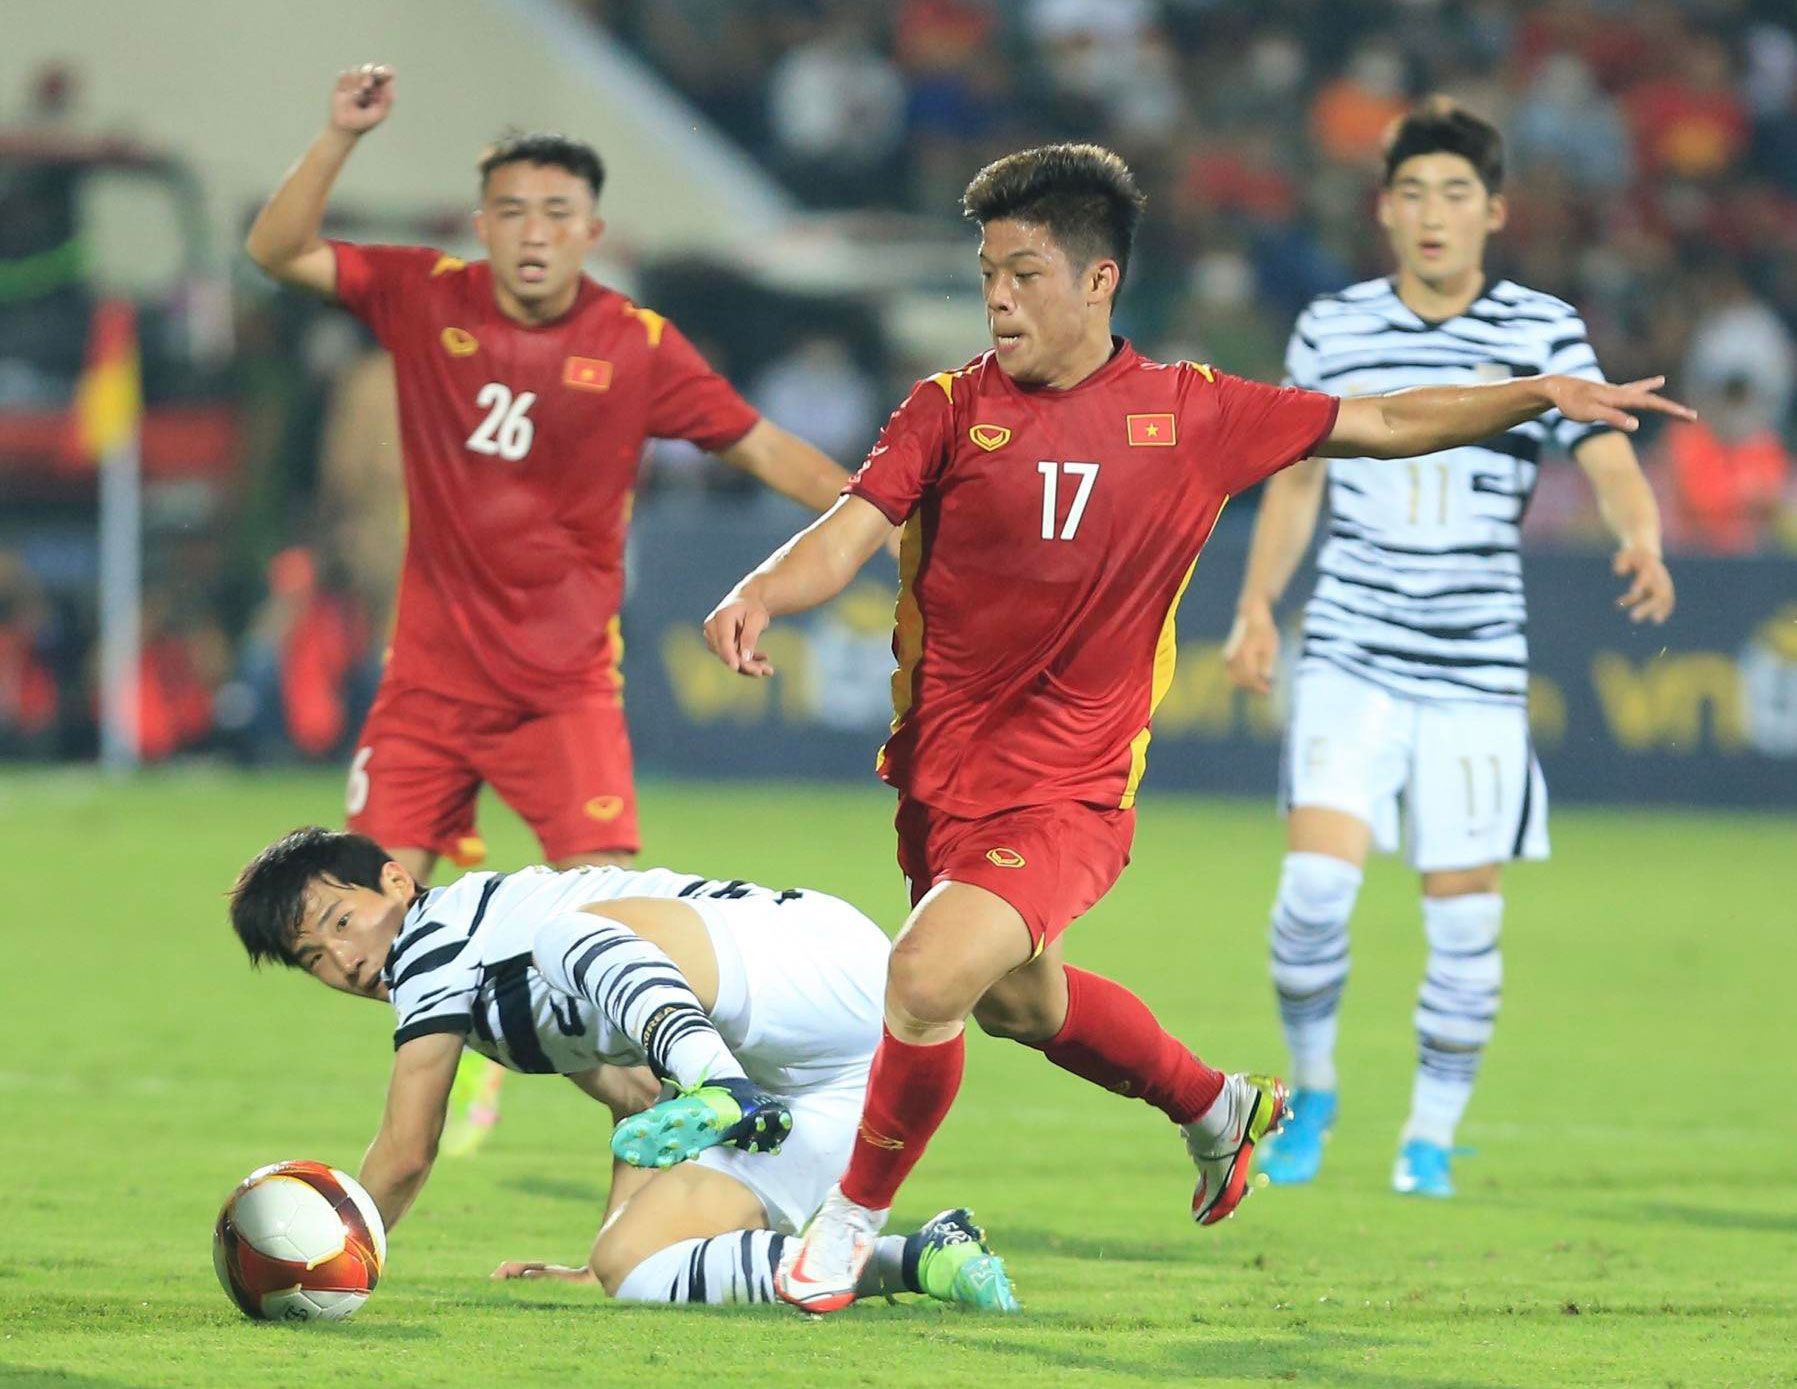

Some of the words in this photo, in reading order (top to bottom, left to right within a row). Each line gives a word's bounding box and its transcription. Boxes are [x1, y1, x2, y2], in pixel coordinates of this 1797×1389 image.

[465, 382, 538, 462] 26
[1037, 461, 1100, 540] 17
[1406, 463, 1450, 526] 11
[1458, 754, 1501, 818] 11
